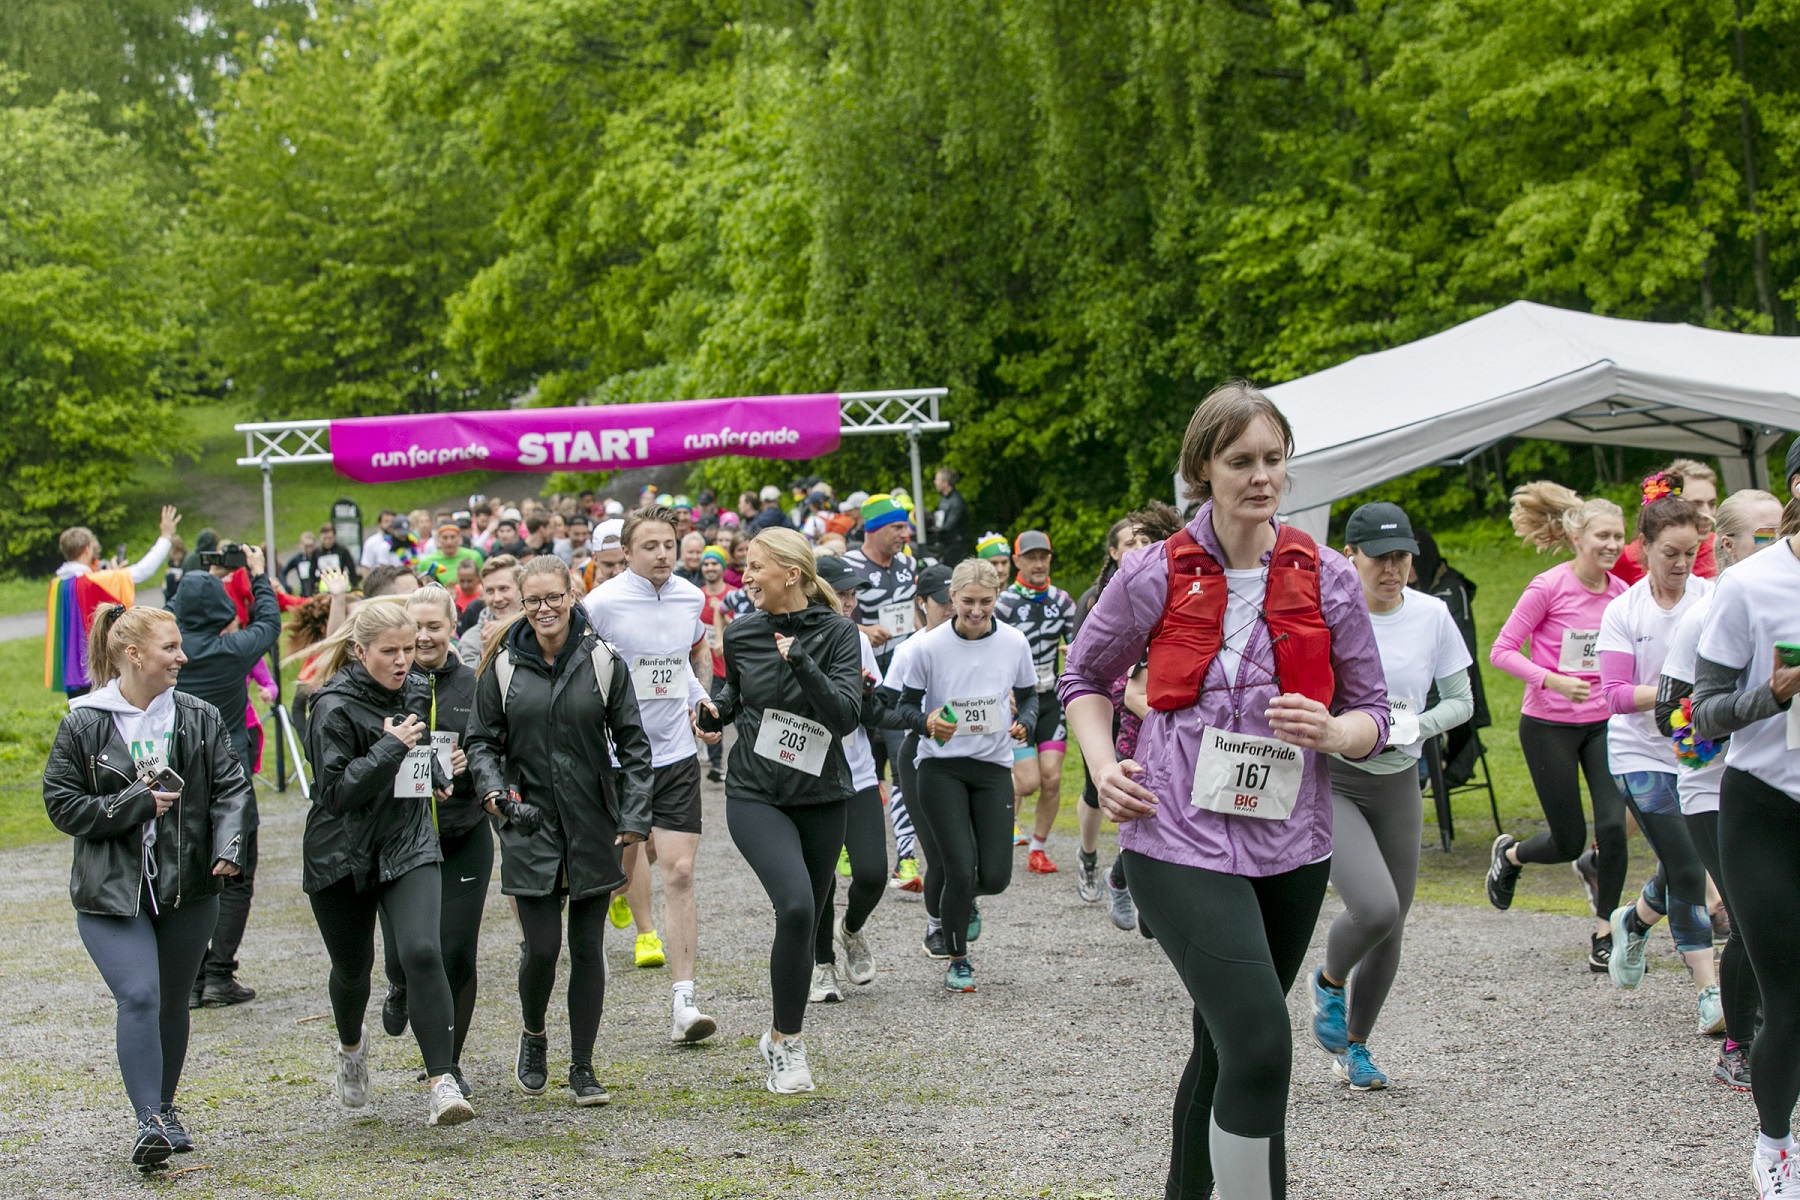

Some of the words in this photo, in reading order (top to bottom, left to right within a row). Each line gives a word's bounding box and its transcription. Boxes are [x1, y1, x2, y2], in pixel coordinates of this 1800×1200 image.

[518, 427, 655, 466] START
[640, 658, 682, 666] RunForPride
[652, 669, 672, 684] 212
[952, 699, 997, 707] RunForPride
[965, 709, 986, 722] 291
[772, 712, 825, 737] RunForPride
[779, 729, 807, 752] 203
[1215, 736, 1296, 760] RunForPride
[780, 749, 796, 762] BIG
[413, 763, 430, 779] 214
[1235, 762, 1271, 790] 167
[415, 783, 425, 791] BIG
[1234, 794, 1258, 808] BIG
